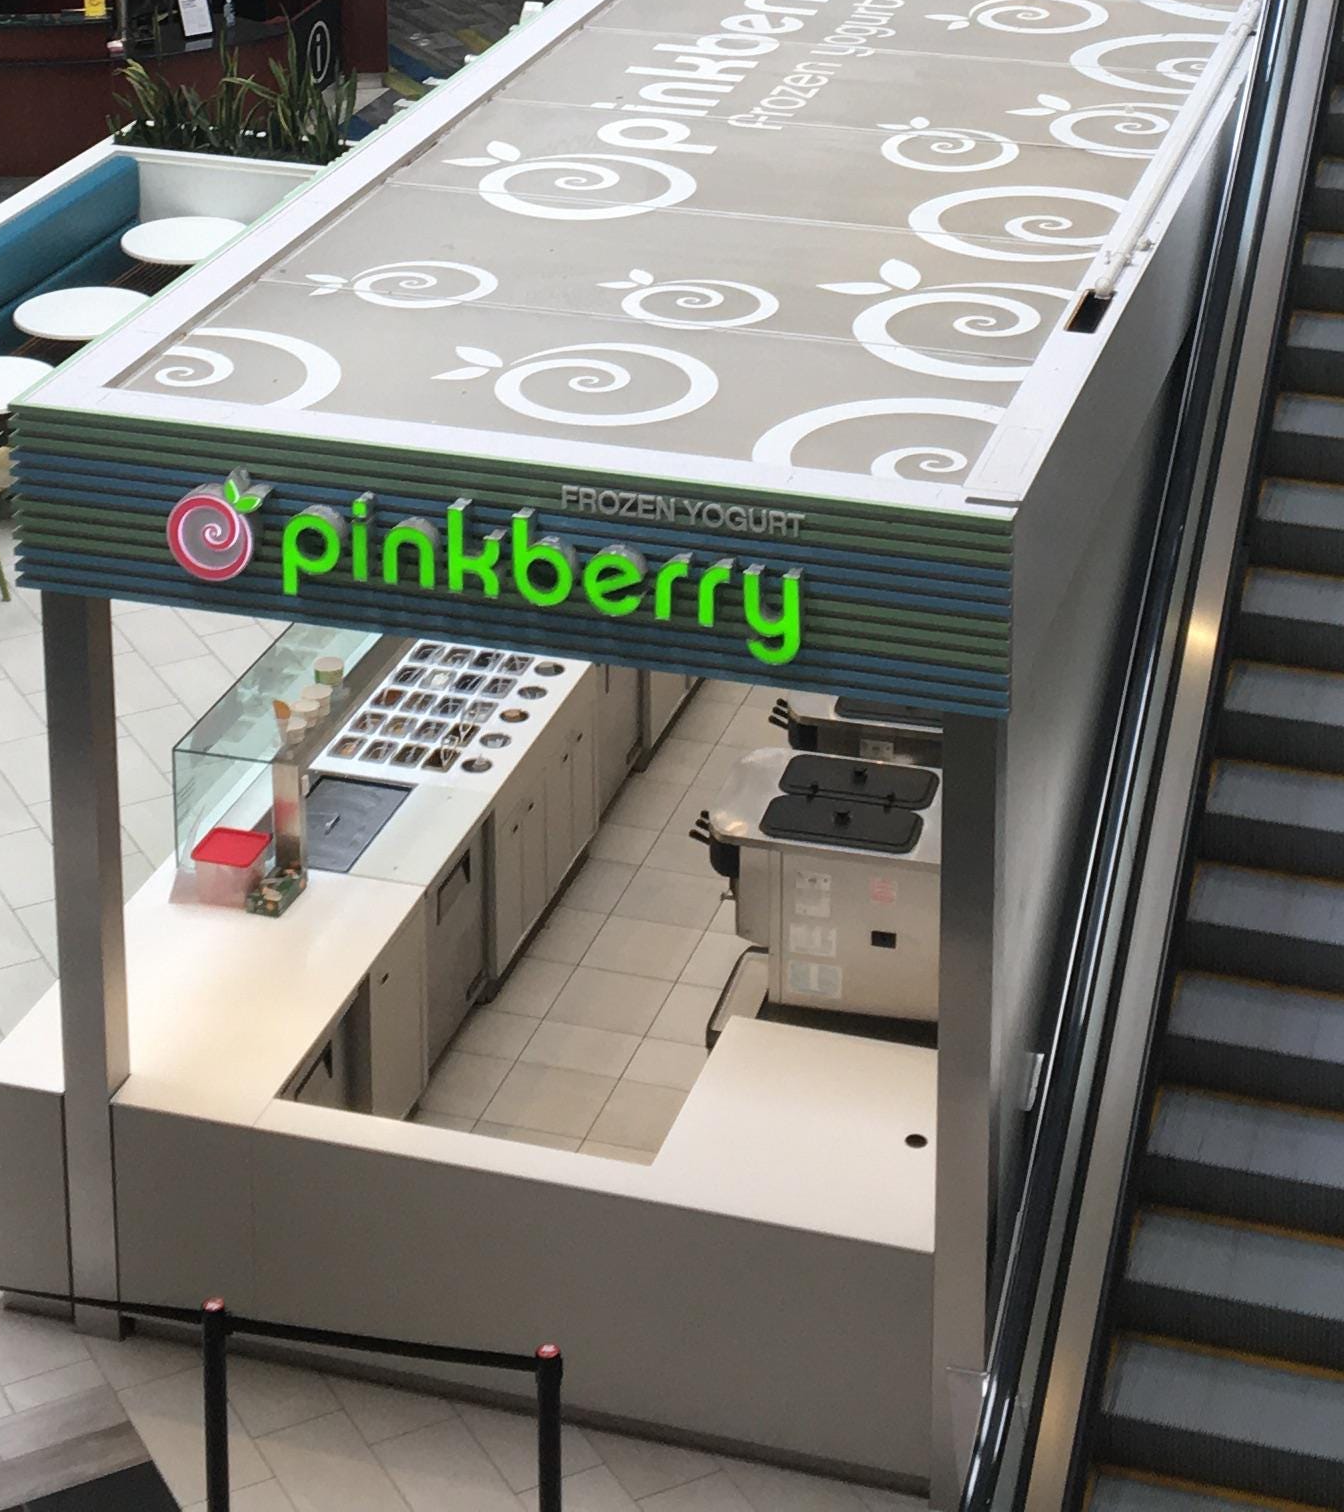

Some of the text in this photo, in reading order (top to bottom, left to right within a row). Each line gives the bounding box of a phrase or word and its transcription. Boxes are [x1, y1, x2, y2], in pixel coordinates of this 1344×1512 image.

[727, 61, 843, 130] frozen
[560, 484, 806, 538] FROZEN YOGURT
[282, 491, 803, 666] pinkberry
